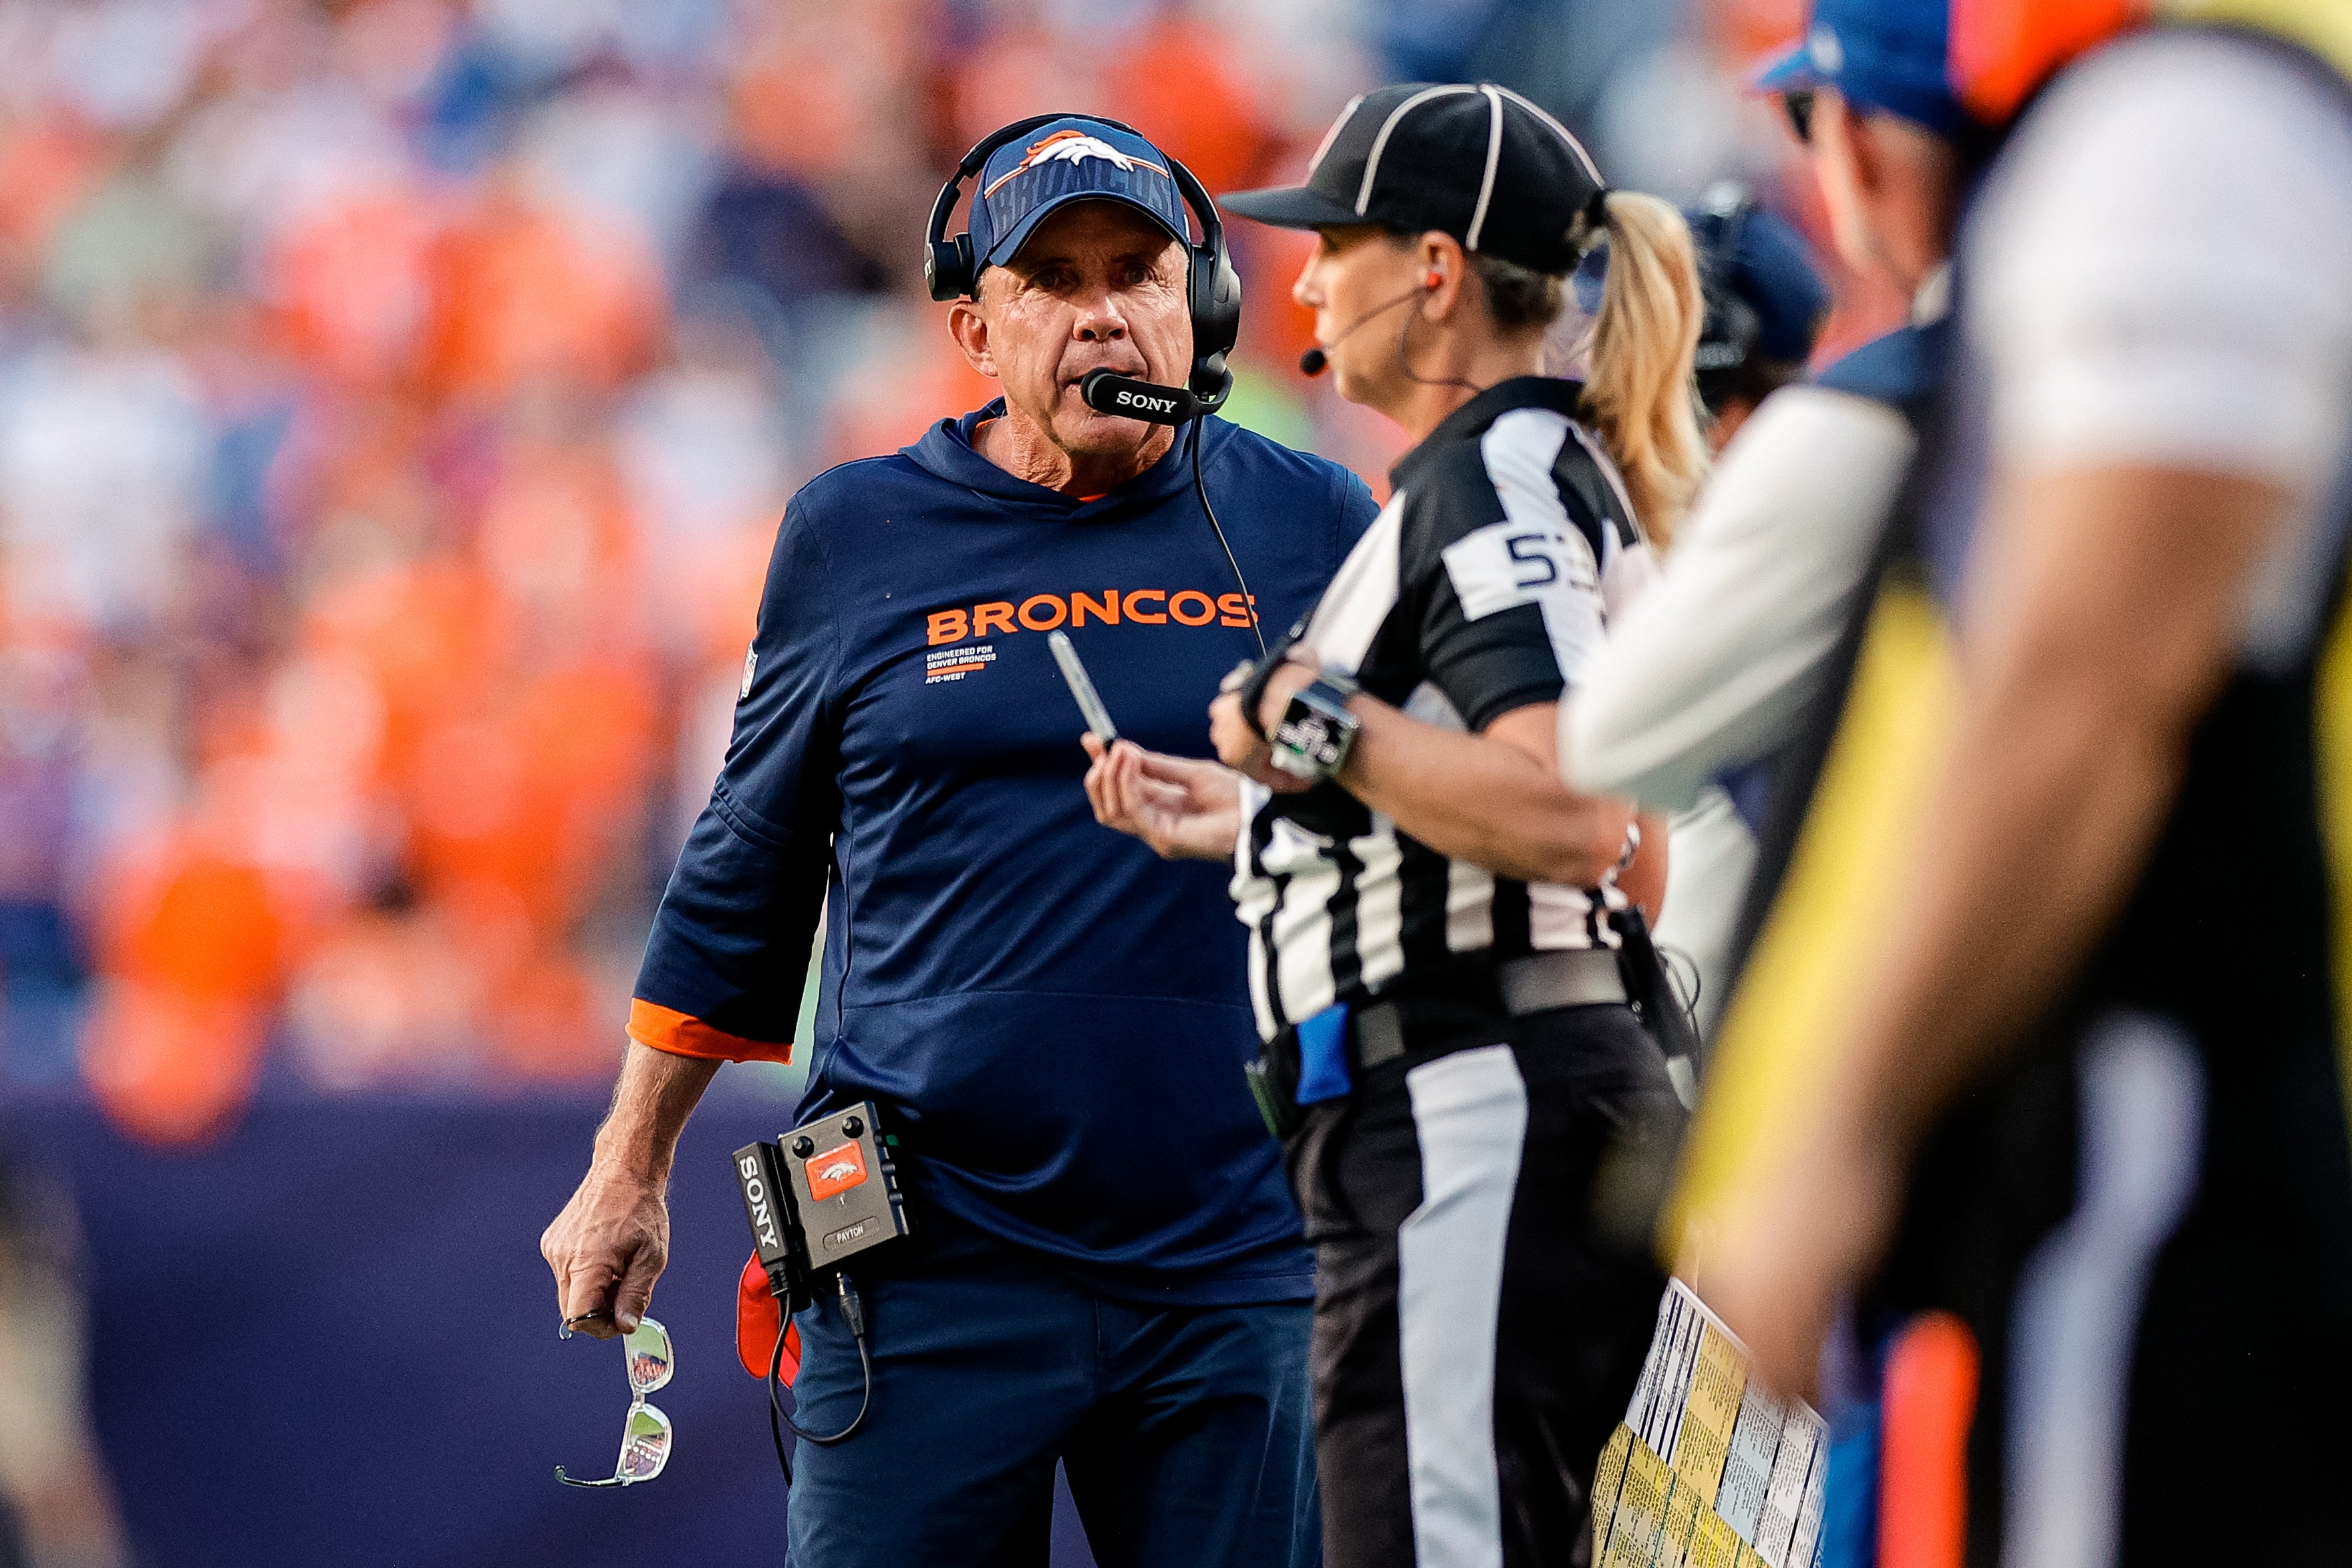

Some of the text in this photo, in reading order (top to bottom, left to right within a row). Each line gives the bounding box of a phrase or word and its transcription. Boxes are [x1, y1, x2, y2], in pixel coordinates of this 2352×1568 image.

[1117, 391, 1177, 414] SONY
[927, 589, 1259, 645] BRONCOS
[927, 645, 993, 661] ENGINEERED FOR
[927, 653, 996, 669] DENVER BRONCOS
[740, 1155, 778, 1249] SONY
[837, 1223, 864, 1243] PAYTON
